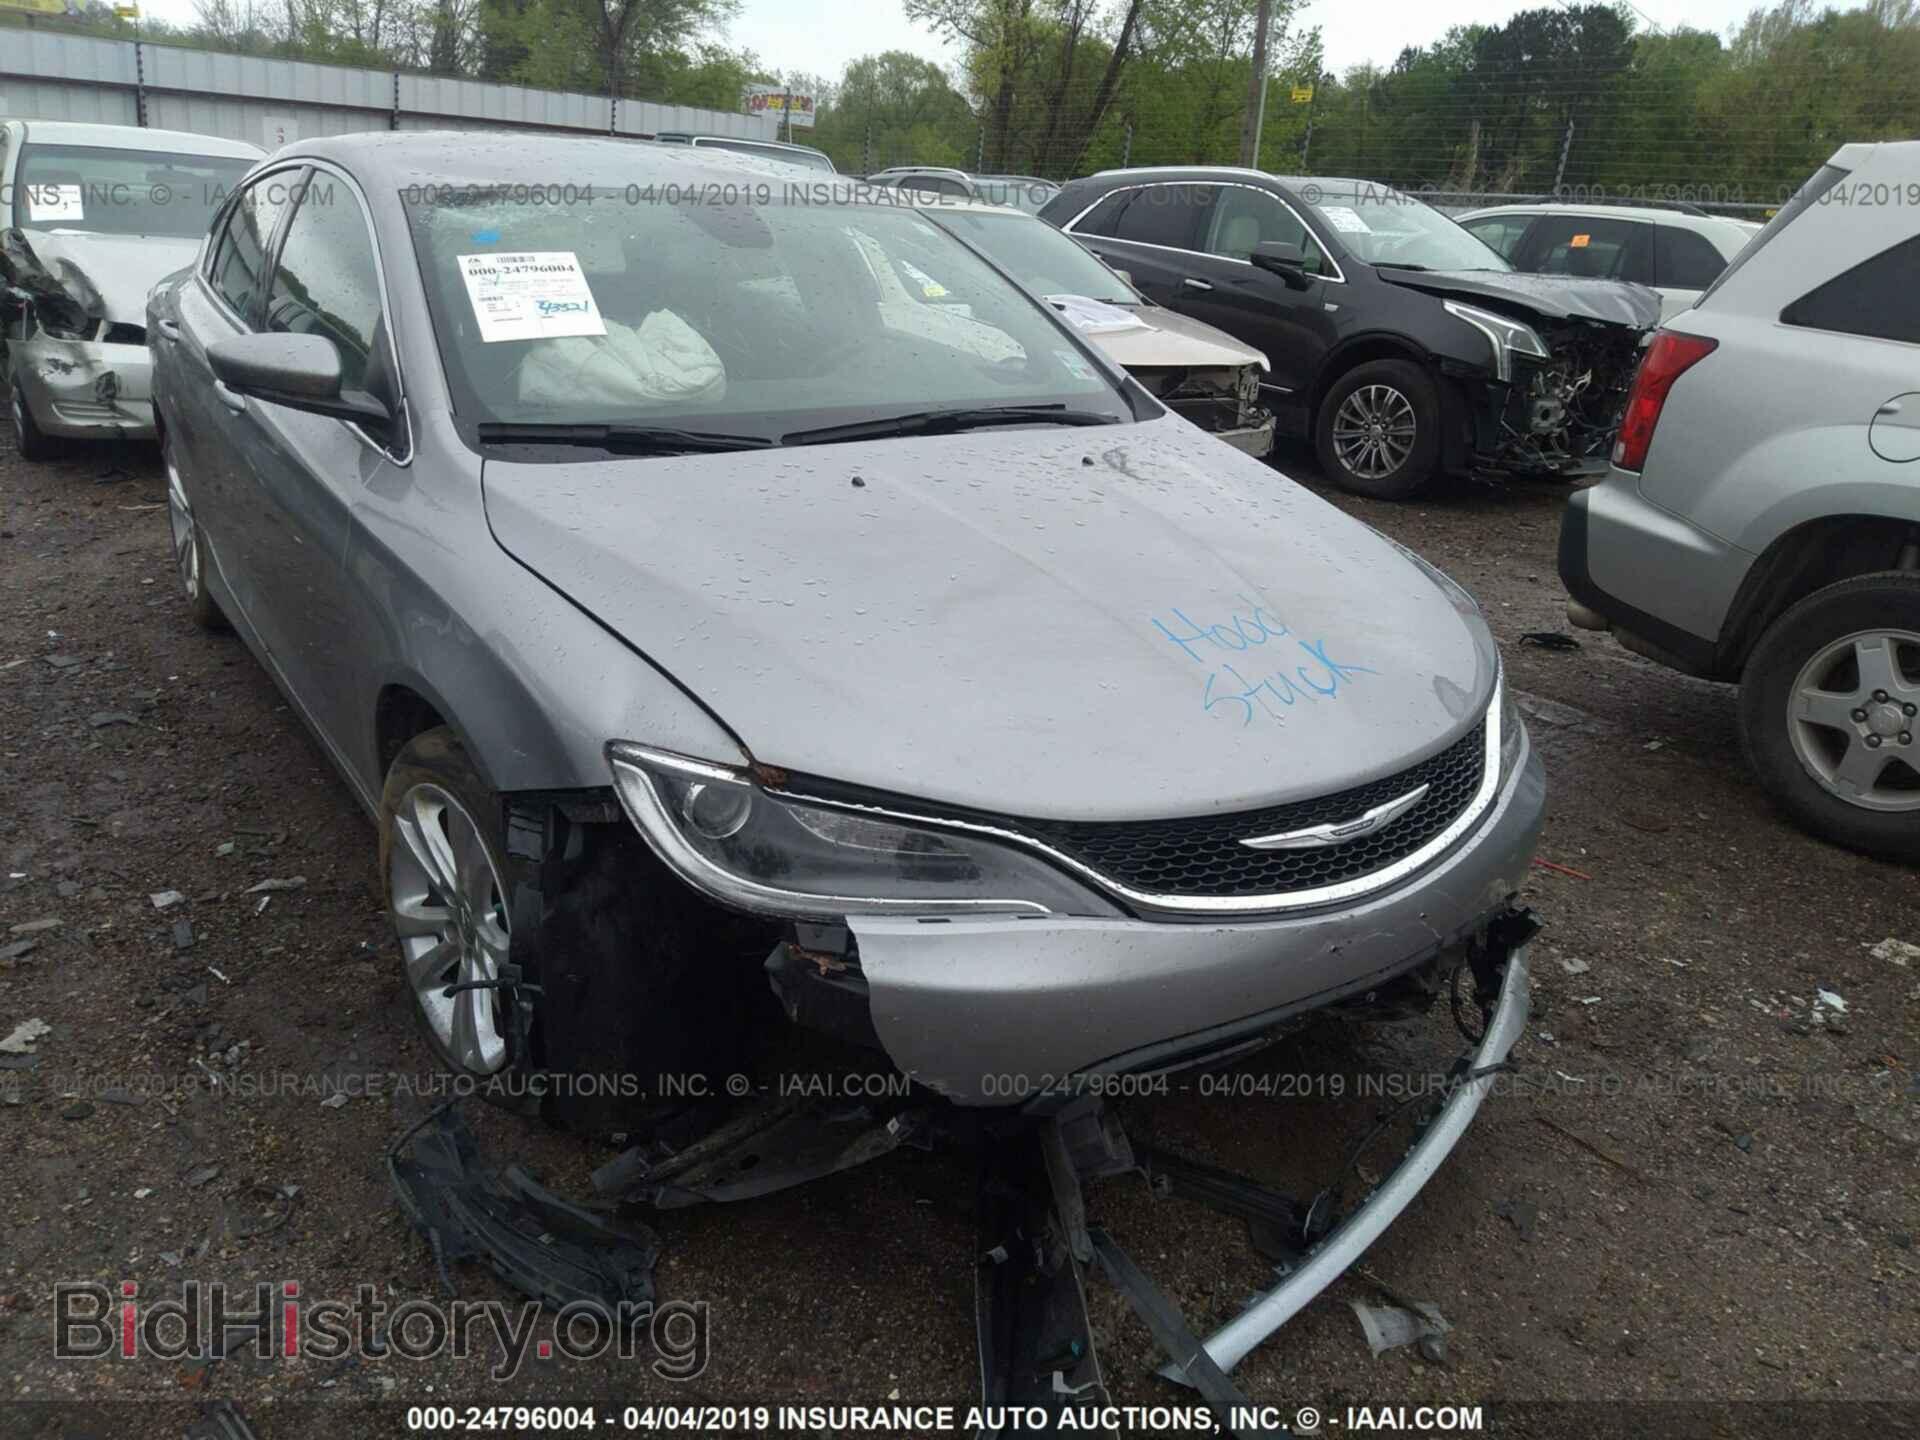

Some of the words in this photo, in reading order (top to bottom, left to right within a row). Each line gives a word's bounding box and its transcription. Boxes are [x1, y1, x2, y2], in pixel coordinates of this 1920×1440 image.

[468, 264, 575, 277] 000-24796004
[1152, 595, 1290, 663] Hood
[1205, 640, 1383, 728] Stuck
